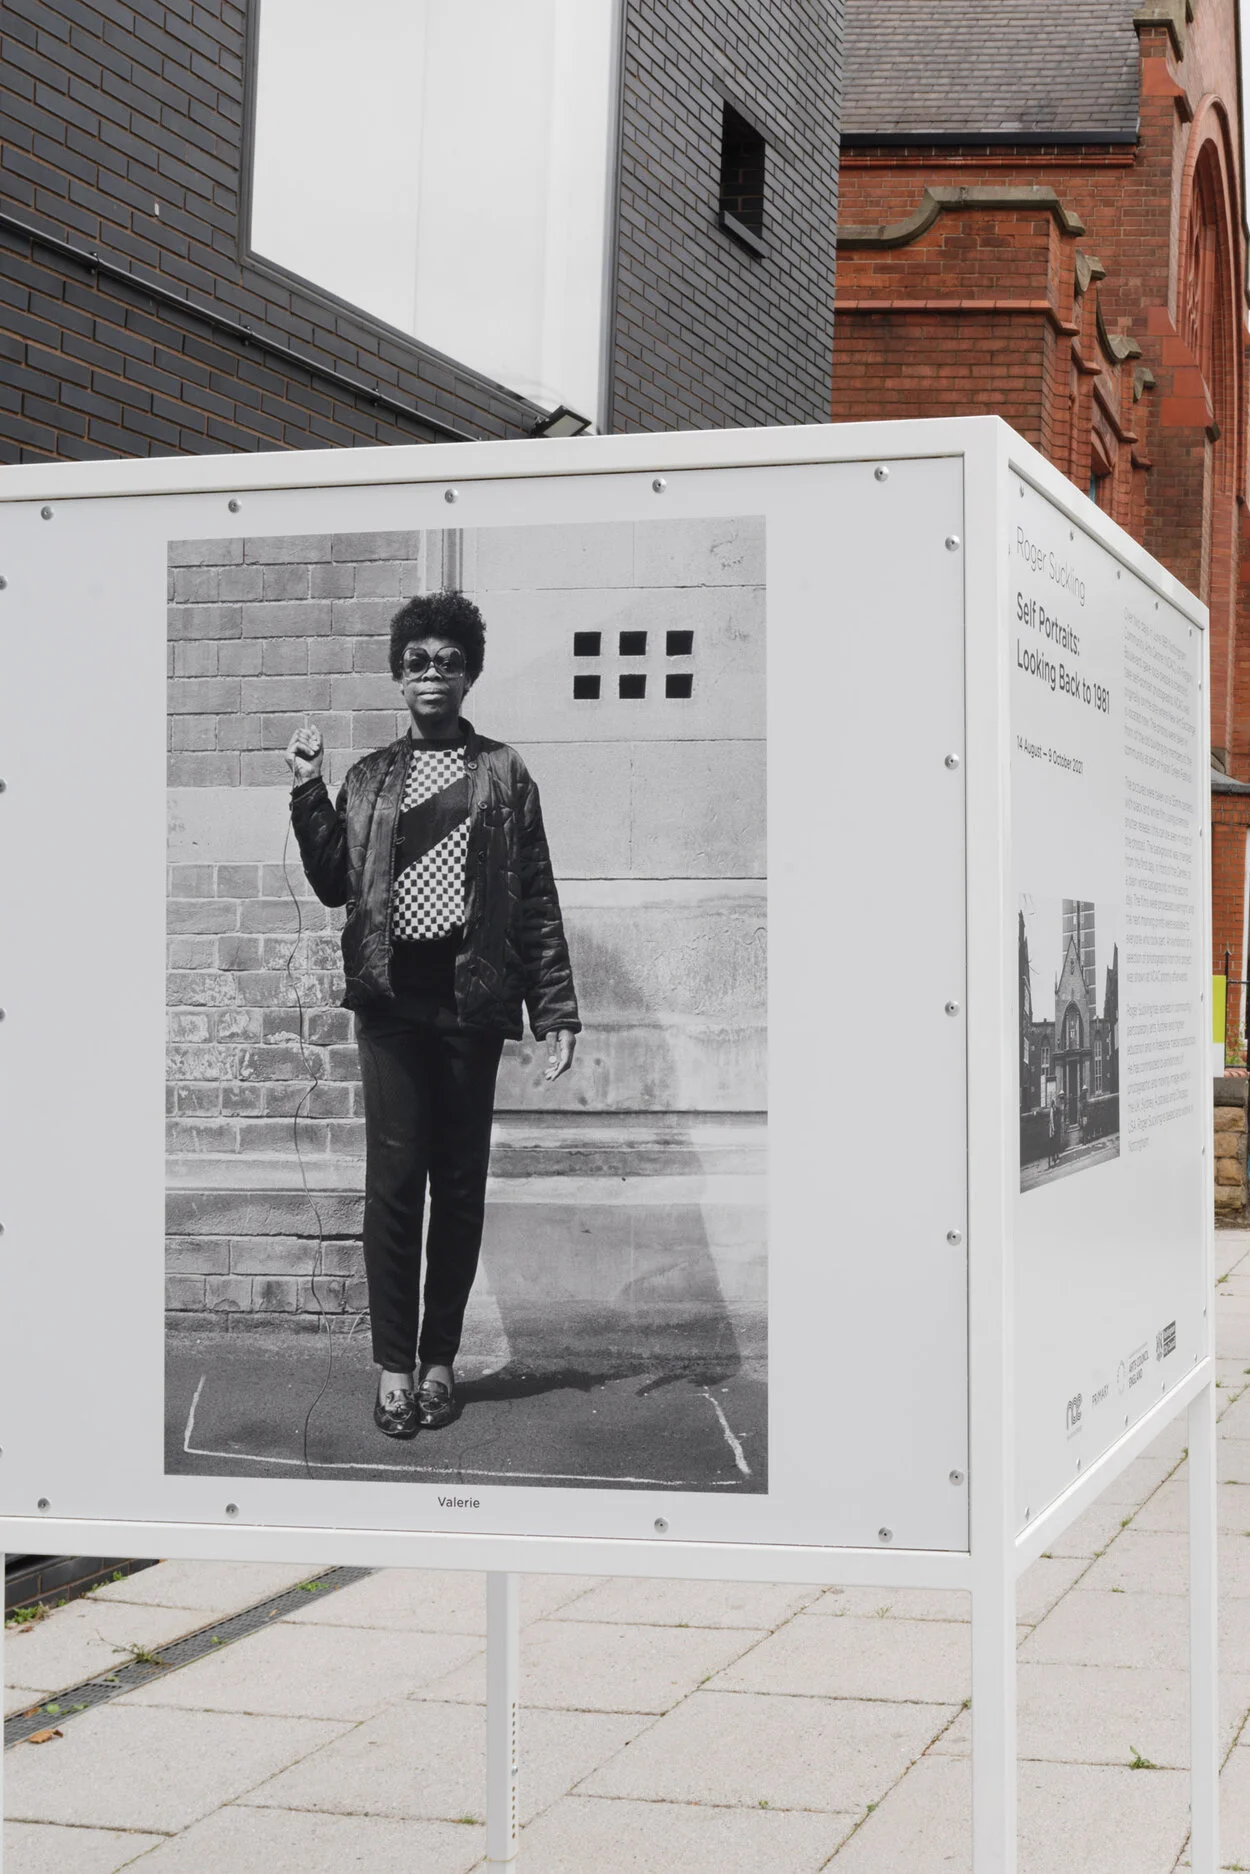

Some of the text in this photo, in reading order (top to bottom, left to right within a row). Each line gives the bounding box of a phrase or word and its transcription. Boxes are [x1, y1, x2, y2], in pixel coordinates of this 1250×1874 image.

[1017, 526, 1085, 607] Roger Suckling
[1017, 591, 1080, 657] Self Portraits:
[1017, 638, 1110, 715] Looking Back to 1981
[1017, 735, 1023, 751] 14
[1024, 738, 1042, 759] August
[1053, 749, 1072, 771] October
[437, 1496, 481, 1509] Valerie
